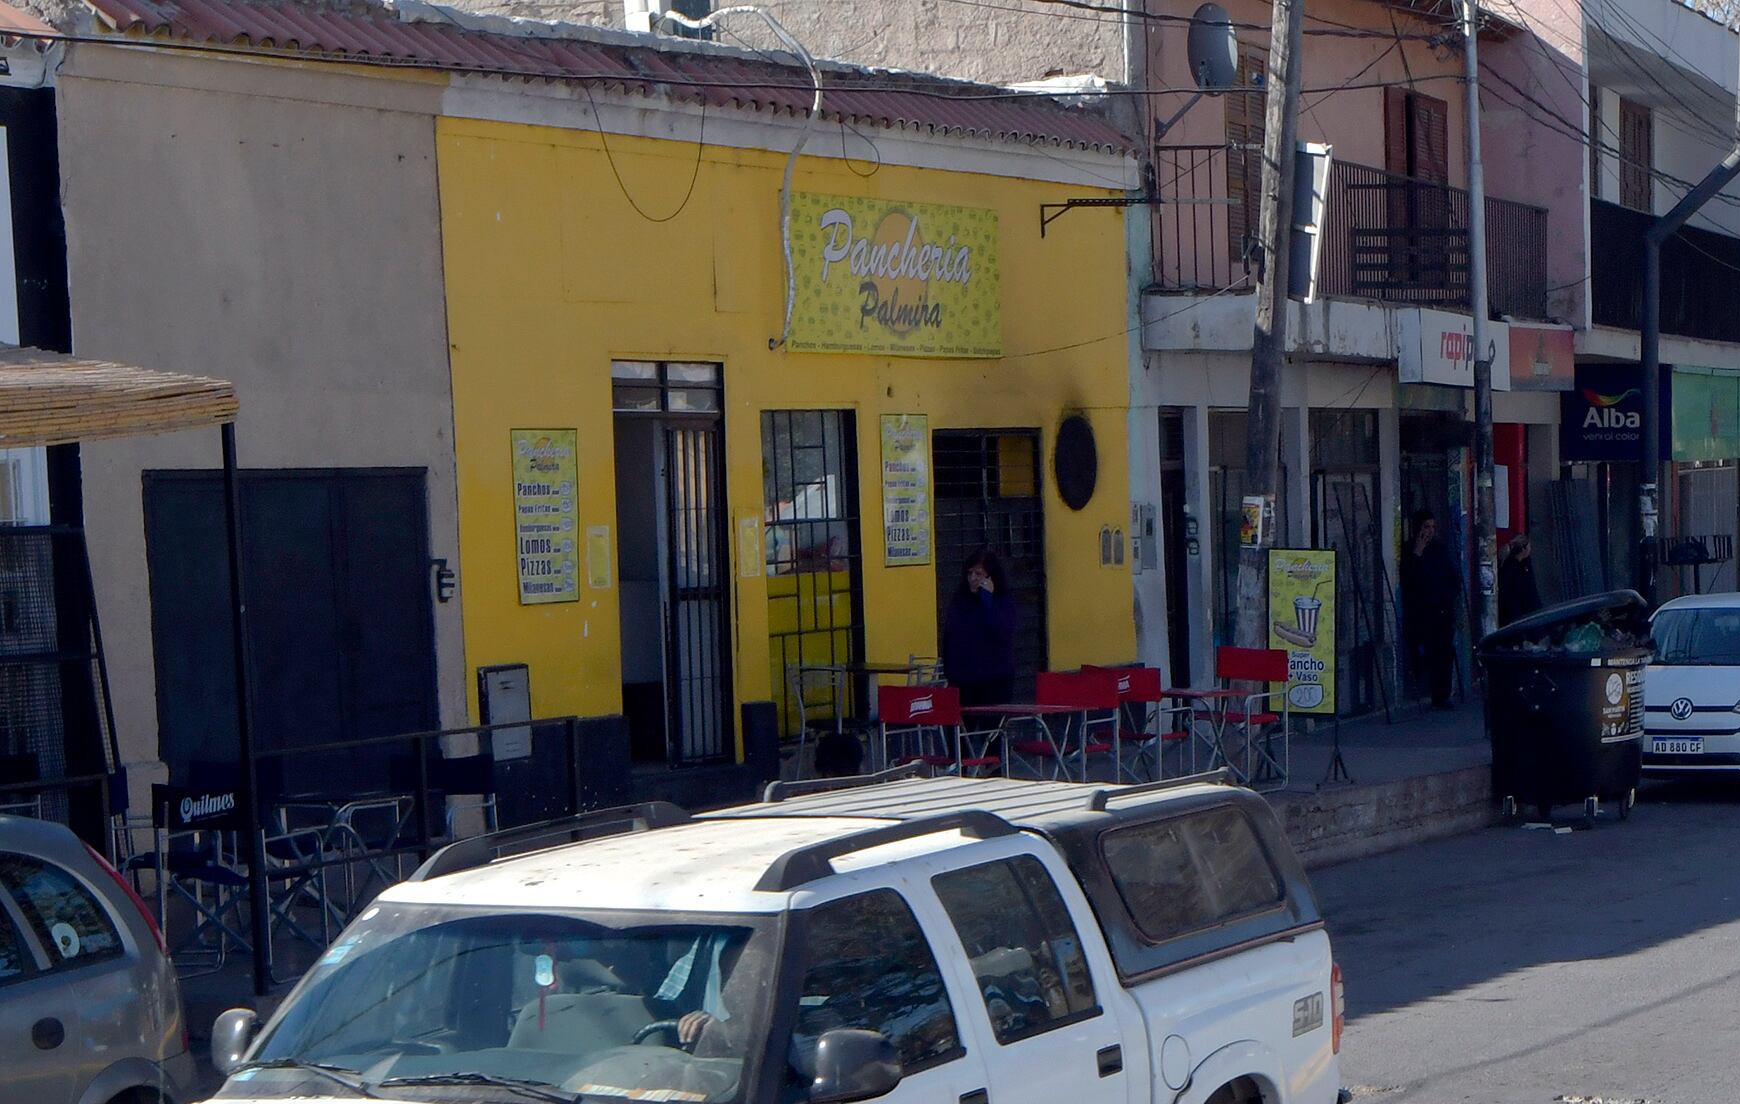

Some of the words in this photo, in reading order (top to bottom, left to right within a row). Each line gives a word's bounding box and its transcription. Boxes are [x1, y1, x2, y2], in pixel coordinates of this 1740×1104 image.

[859, 281, 942, 329] Palmira
[1441, 323, 1496, 371] rapipo
[1583, 407, 1640, 429] Alba
[1615, 431, 1640, 441] color
[517, 482, 551, 496] Panchos
[518, 504, 533, 514] Papas
[887, 526, 910, 542] Pizzas
[520, 536, 552, 555] Lomos
[520, 558, 552, 576] Pizzas
[1287, 658, 1324, 671] ancho
[1296, 672, 1318, 681] Vaso
[1655, 742, 1667, 752] AD
[1669, 742, 1687, 752] 880
[180, 793, 235, 823] Quilmes
